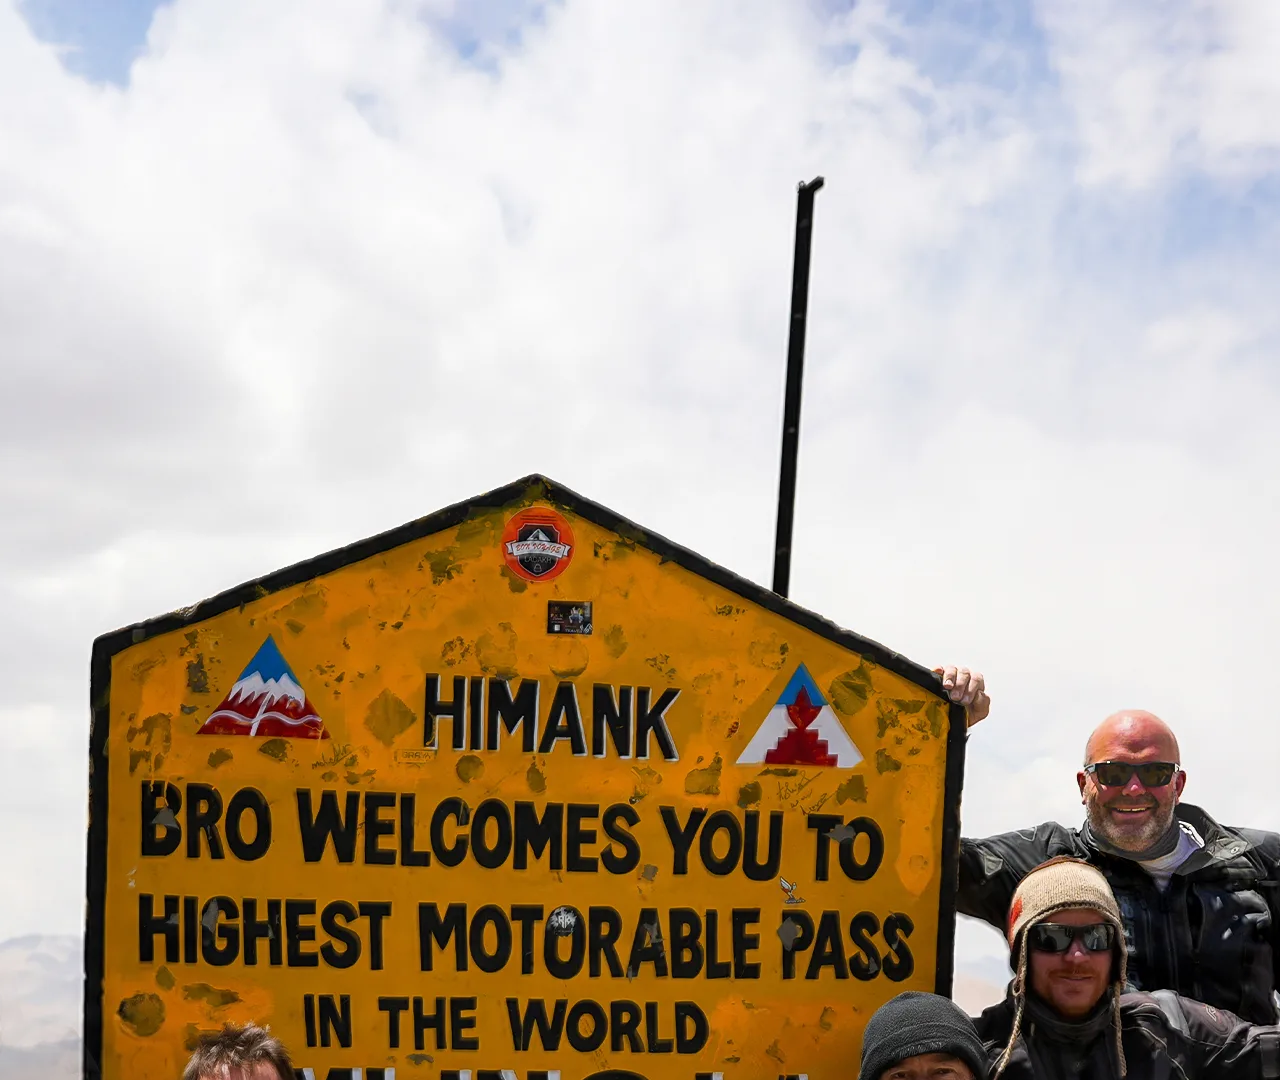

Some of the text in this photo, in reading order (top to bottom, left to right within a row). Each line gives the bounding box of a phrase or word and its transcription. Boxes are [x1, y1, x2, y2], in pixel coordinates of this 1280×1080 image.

[423, 674, 682, 762] HIMANK
[141, 780, 886, 883] BRO WELCOMES YOU TO
[138, 893, 916, 984] HIGHEST MOTORABLE PASS
[304, 994, 710, 1056] IN THE WORLD
